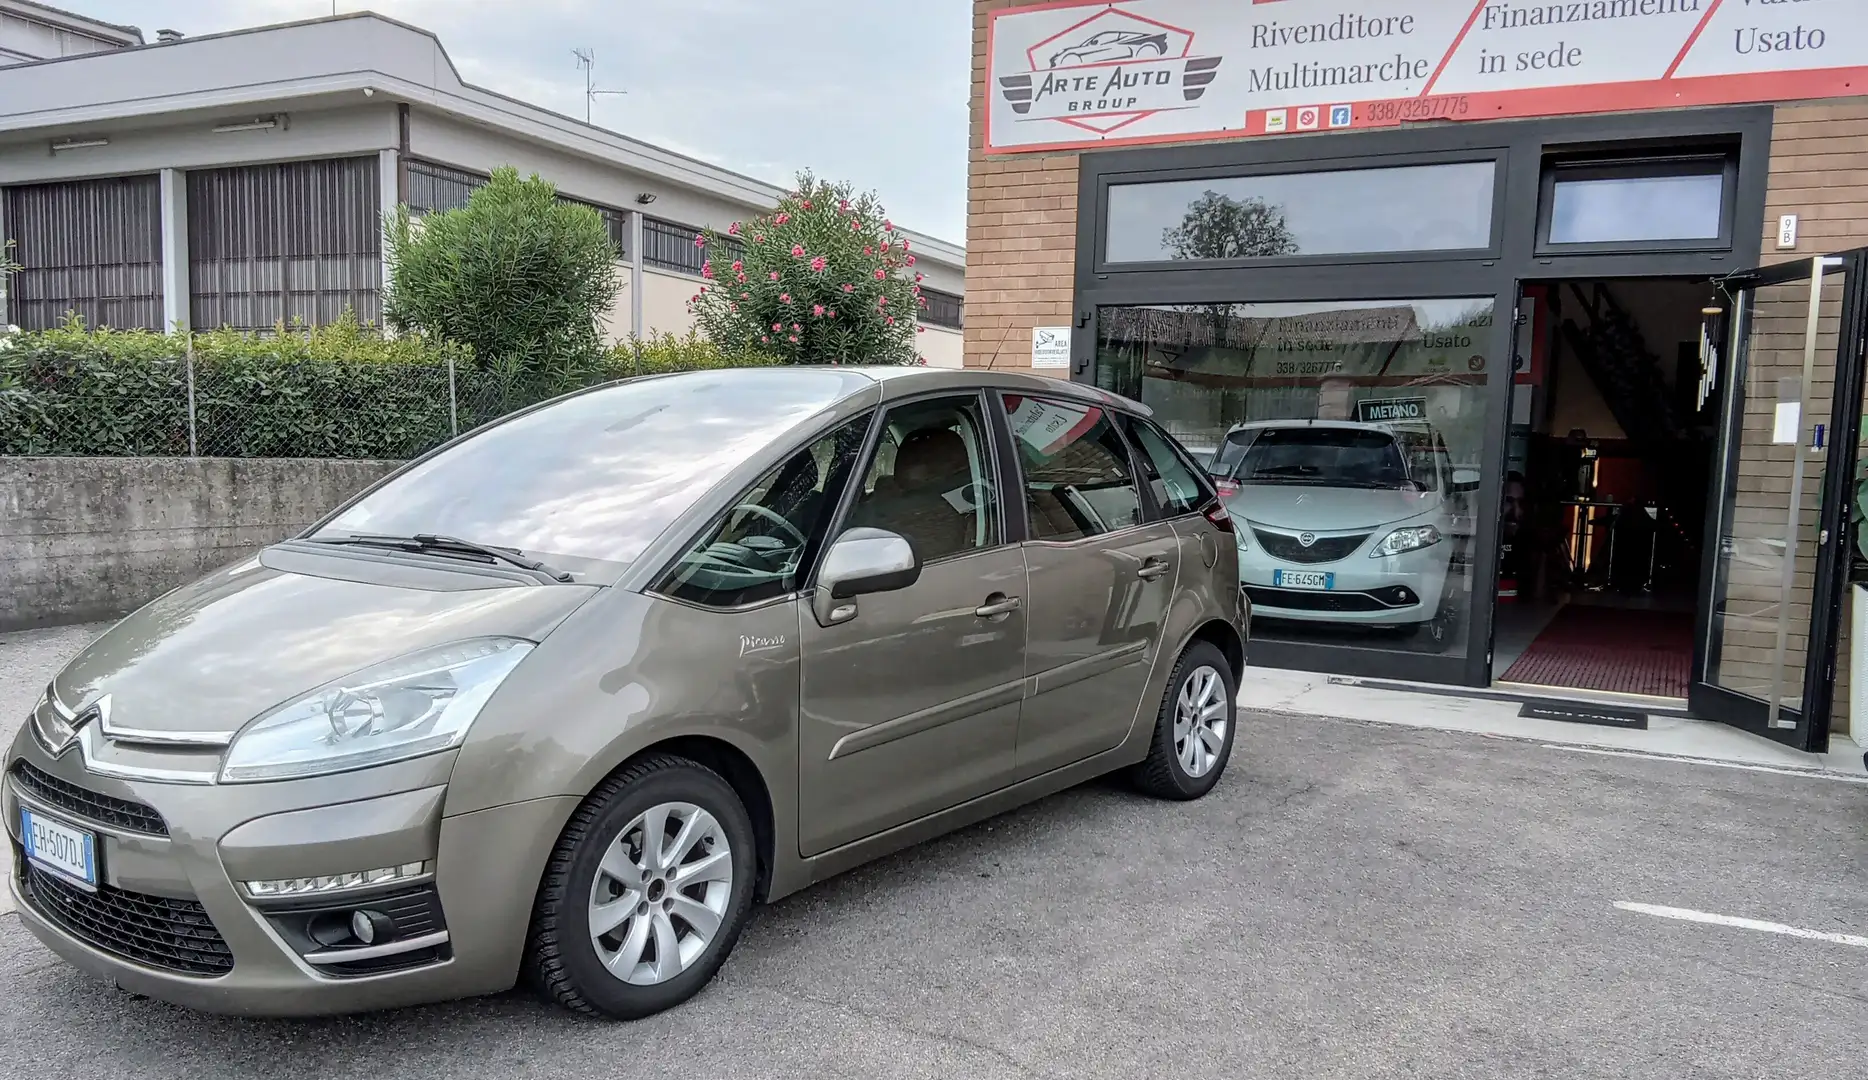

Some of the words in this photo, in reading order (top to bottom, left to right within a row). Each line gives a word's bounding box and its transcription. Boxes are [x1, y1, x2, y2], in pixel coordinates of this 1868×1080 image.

[1250, 13, 1414, 48] Rivenditore
[1734, 25, 1825, 54] Usato
[1478, 49, 1506, 74] in
[1515, 41, 1582, 71] sede
[1035, 72, 1098, 102] ARTE
[1102, 66, 1171, 97] AUTO
[1248, 54, 1428, 93] Multimarche
[1068, 97, 1137, 111] GROUP
[1367, 96, 1468, 121] 338/3267775
[1424, 333, 1471, 348] Usato
[1370, 404, 1419, 419] METANO
